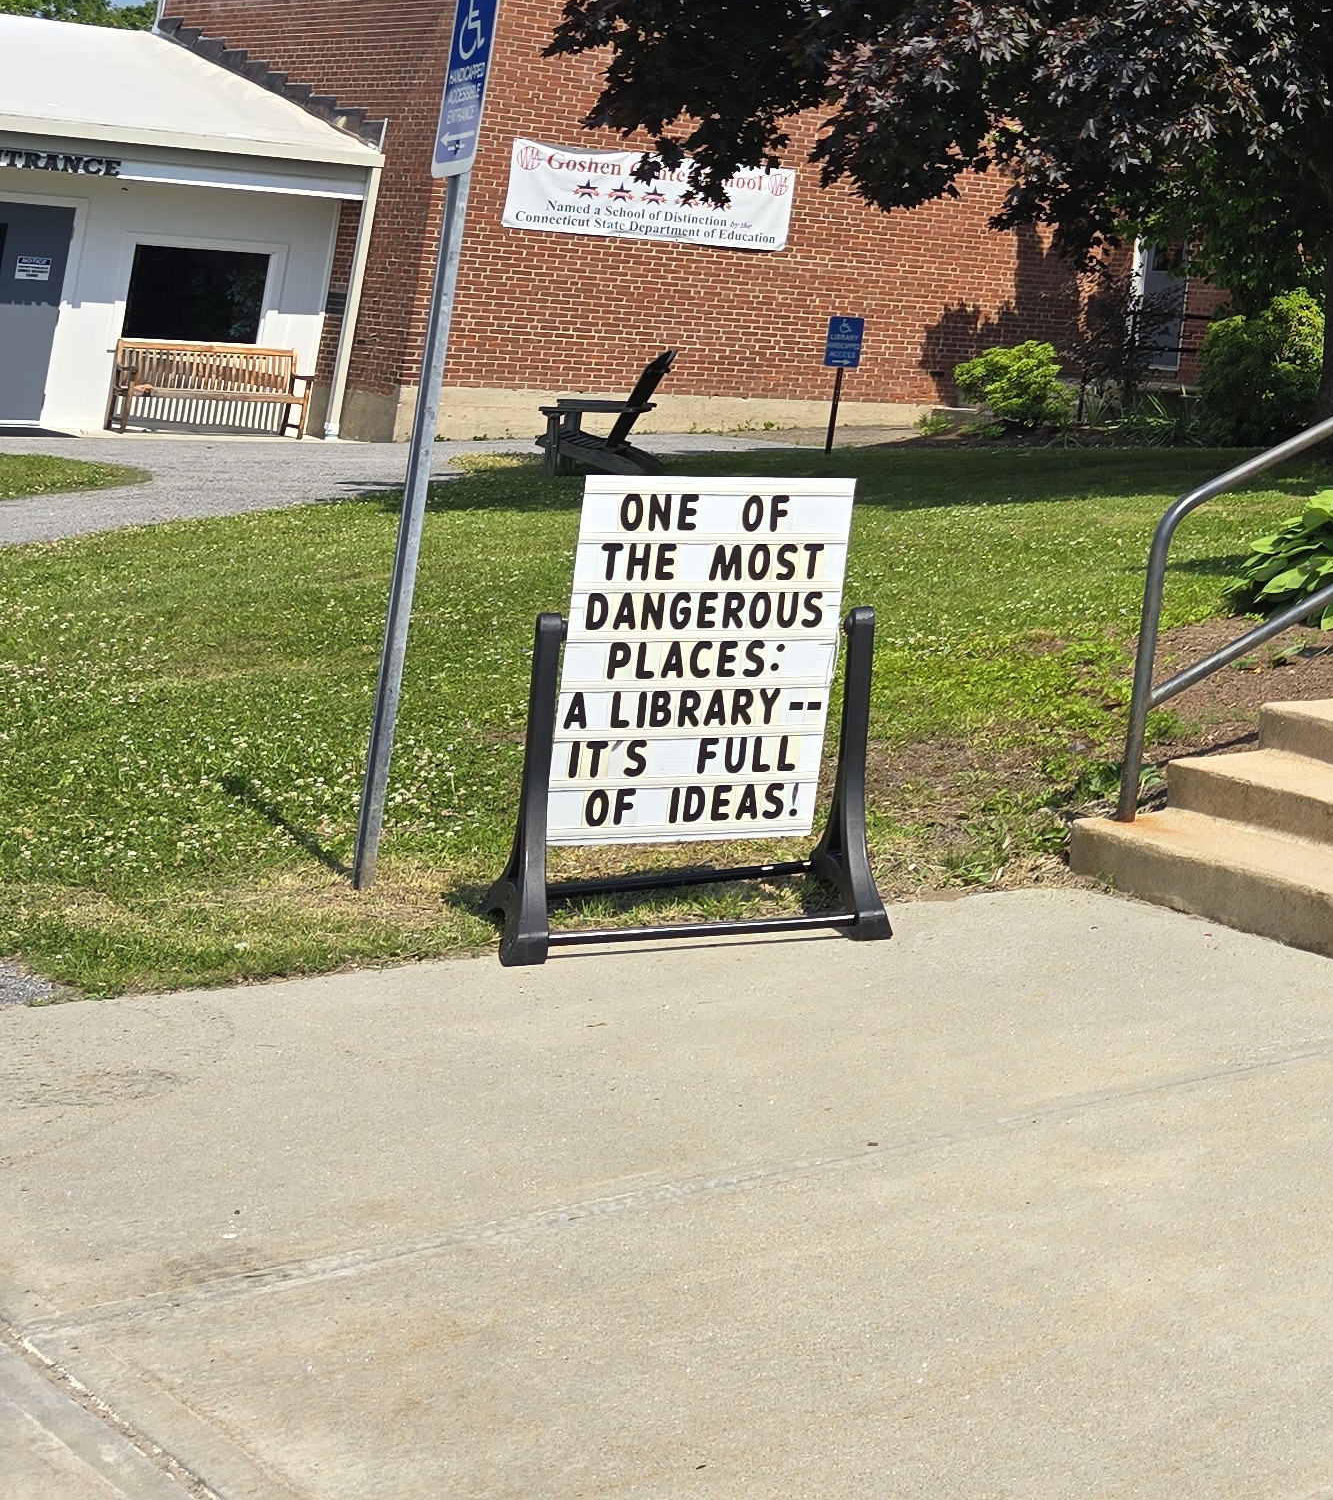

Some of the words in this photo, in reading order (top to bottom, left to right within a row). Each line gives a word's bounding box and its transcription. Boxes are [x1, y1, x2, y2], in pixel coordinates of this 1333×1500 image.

[447, 83, 481, 104] ACCESSIBLE
[446, 104, 476, 125] ENTRANCE
[547, 153, 622, 176] Goshen
[515, 210, 590, 228] Connecticut
[593, 217, 626, 231] State
[629, 221, 700, 237] Department
[703, 229, 716, 239] of
[718, 229, 776, 244] Education
[546, 200, 590, 214] Named
[594, 207, 601, 216] a
[604, 205, 646, 220] School
[648, 210, 661, 221] of
[664, 211, 727, 227] Distinction
[729, 220, 740, 229] by
[740, 221, 753, 230] the
[829, 351, 856, 359] ACCESS
[830, 333, 860, 341] LIBRARY
[620, 493, 700, 532] ONE
[742, 495, 790, 533] OF
[601, 543, 677, 581] THE
[708, 543, 825, 582] MOST
[585, 591, 823, 631] DANGEROUS
[606, 640, 786, 680] PLACES:
[563, 691, 587, 729] A
[568, 739, 648, 778] IT'S
[696, 735, 796, 774] FULL
[585, 788, 637, 827] OF
[668, 782, 800, 824] IDEAS!
